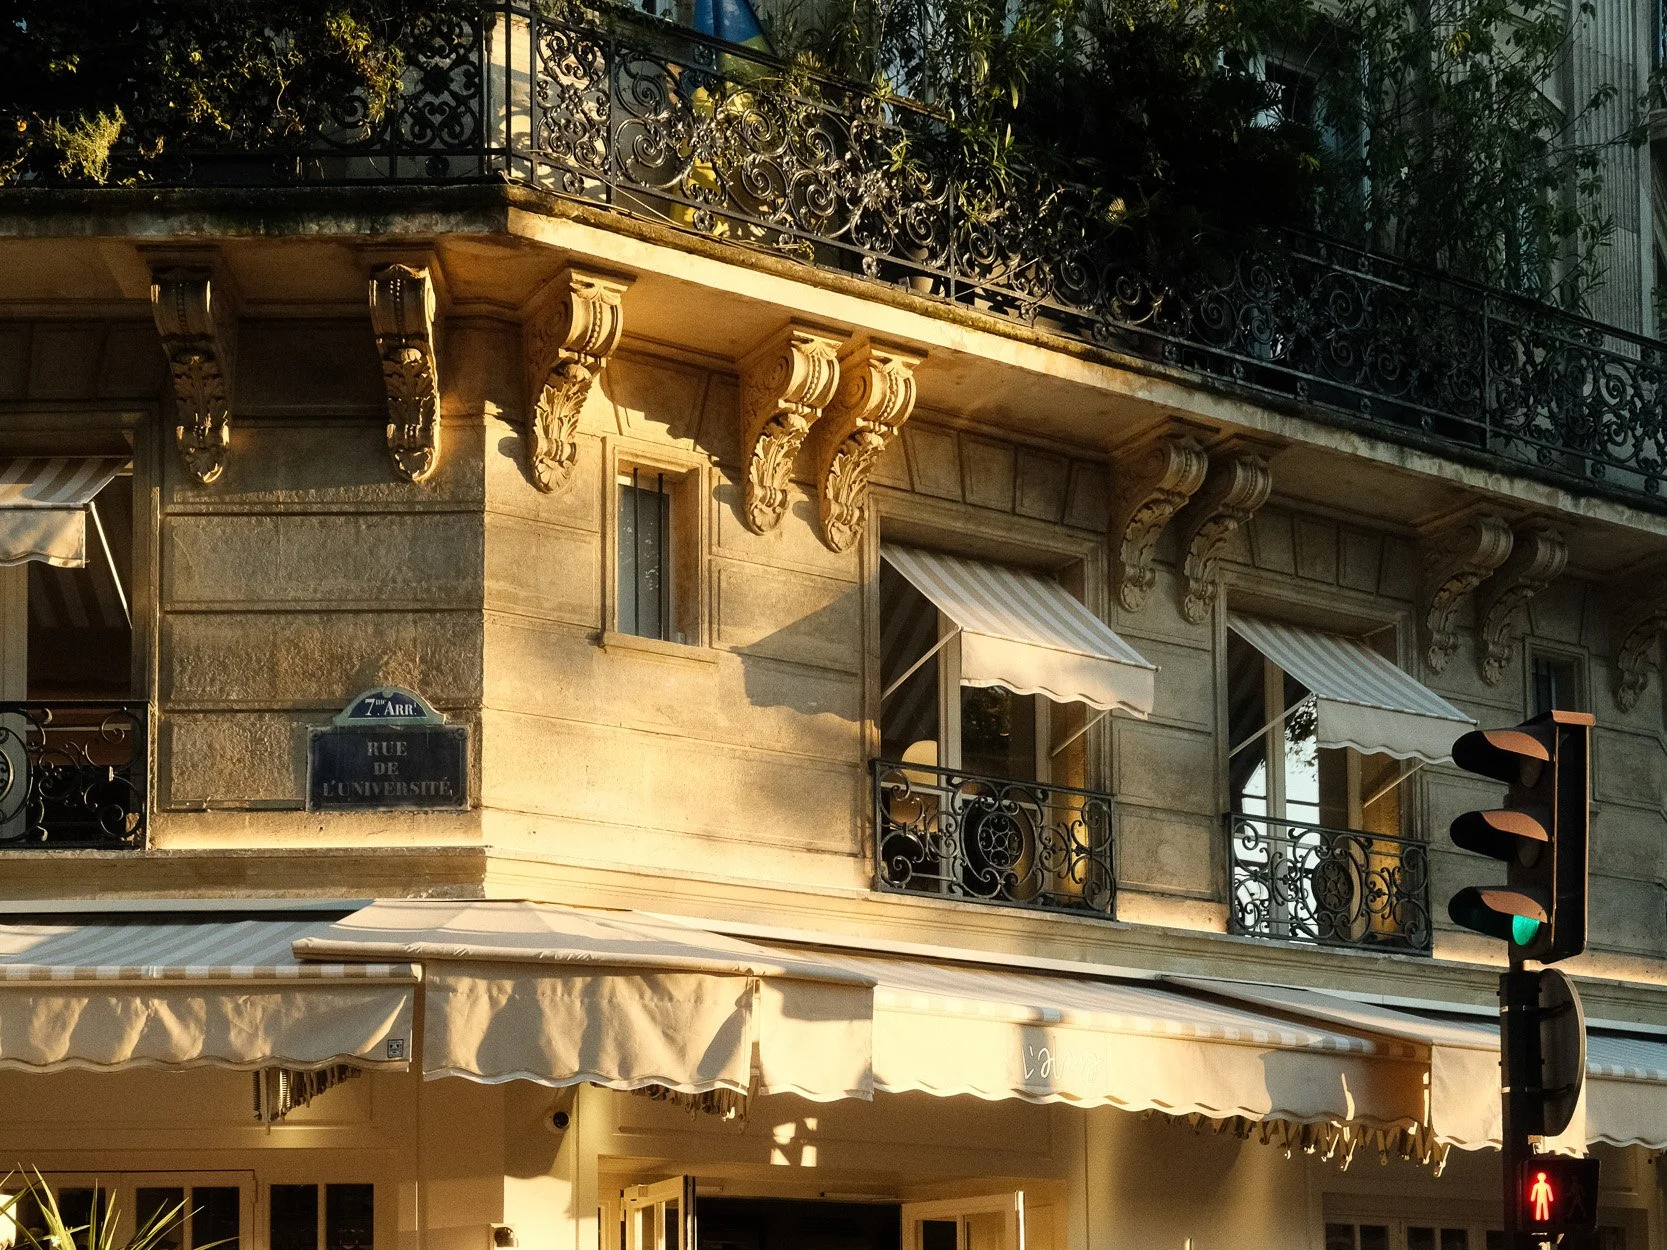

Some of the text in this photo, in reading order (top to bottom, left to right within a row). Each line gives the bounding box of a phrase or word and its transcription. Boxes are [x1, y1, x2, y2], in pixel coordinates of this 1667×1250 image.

[367, 741, 408, 757] RUE
[374, 762, 399, 775] DE
[323, 777, 451, 796] L'UNIVERSITÉ
